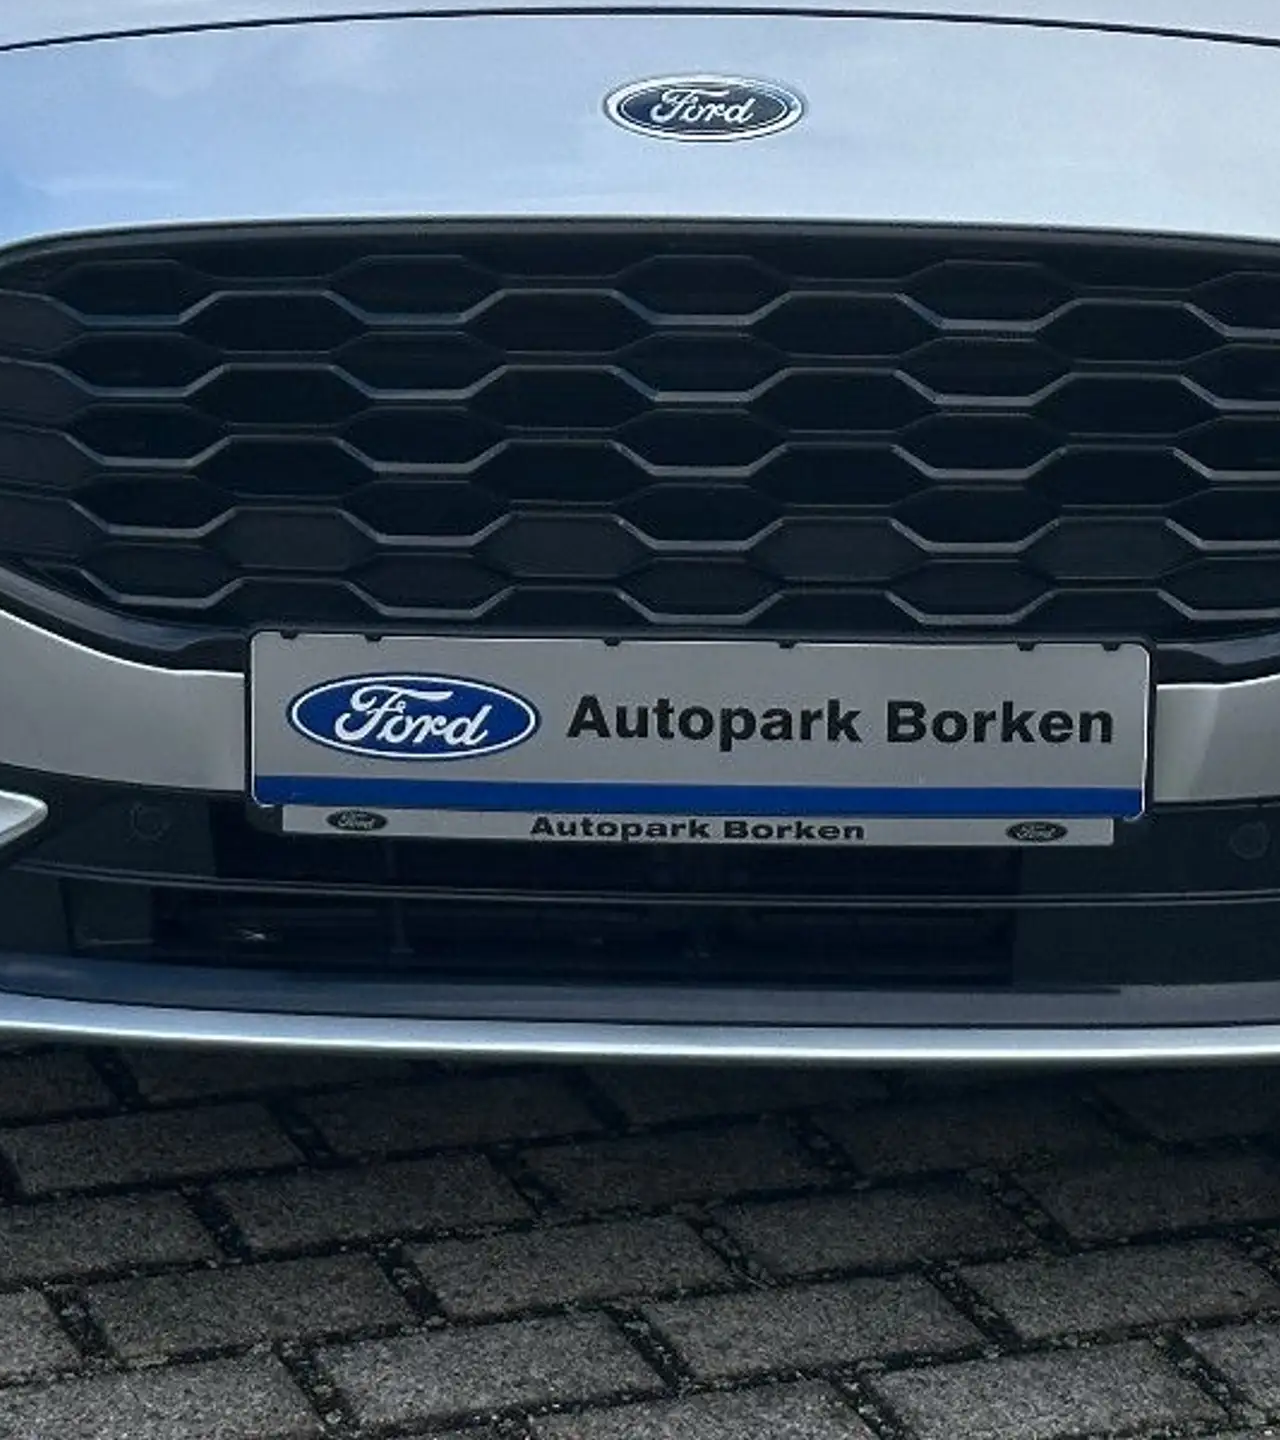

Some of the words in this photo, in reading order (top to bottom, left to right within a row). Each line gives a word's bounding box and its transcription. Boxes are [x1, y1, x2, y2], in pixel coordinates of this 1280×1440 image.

[649, 88, 756, 124] Ford
[334, 684, 493, 746] Ford
[566, 694, 863, 752] Autopark
[886, 699, 1114, 744] Borken
[529, 816, 713, 842] Autopark
[723, 820, 865, 841] Borken
